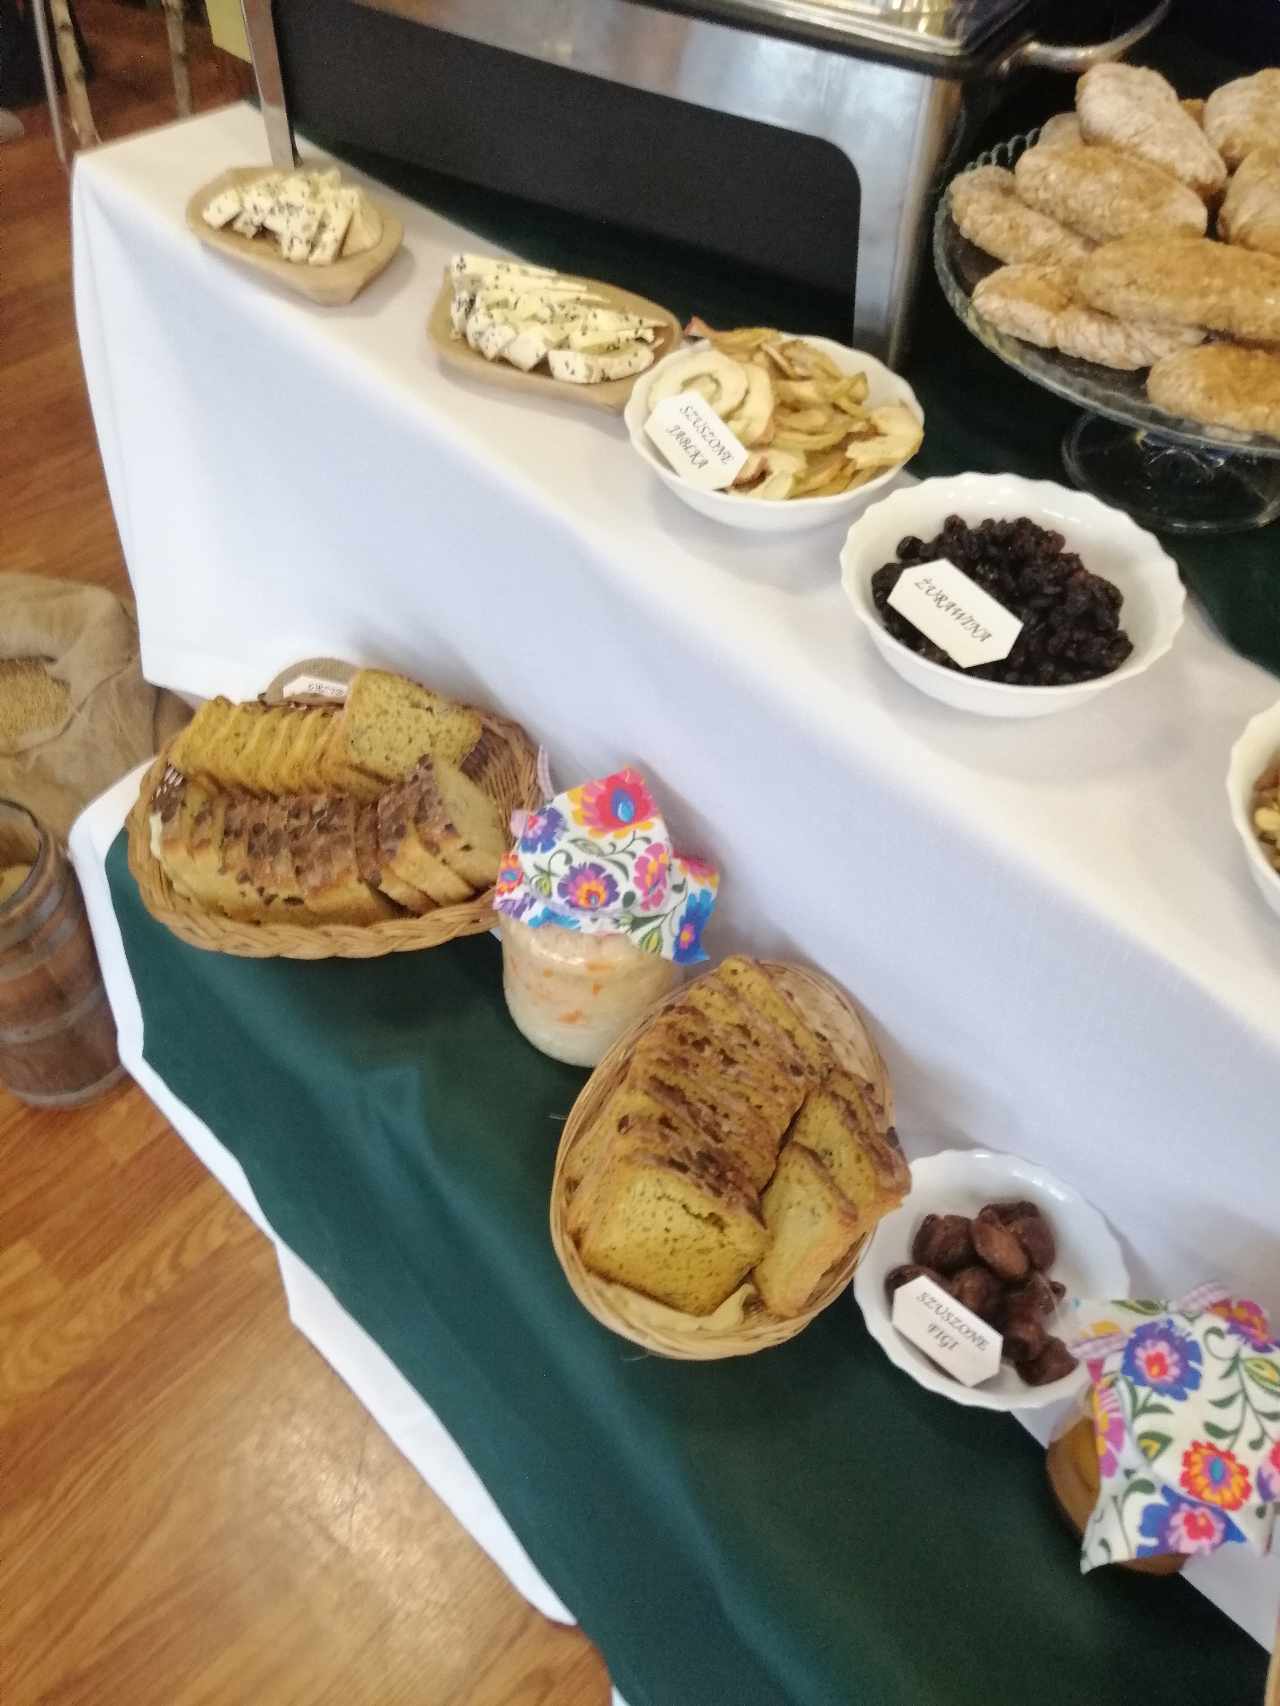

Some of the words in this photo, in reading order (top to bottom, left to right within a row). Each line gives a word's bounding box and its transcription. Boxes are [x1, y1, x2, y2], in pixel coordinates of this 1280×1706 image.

[679, 404, 734, 465] SZUSZONE
[914, 576, 993, 643] ŻURAWINA
[916, 1291, 989, 1352] SZUSZONE
[927, 1322, 959, 1352] FIGI
